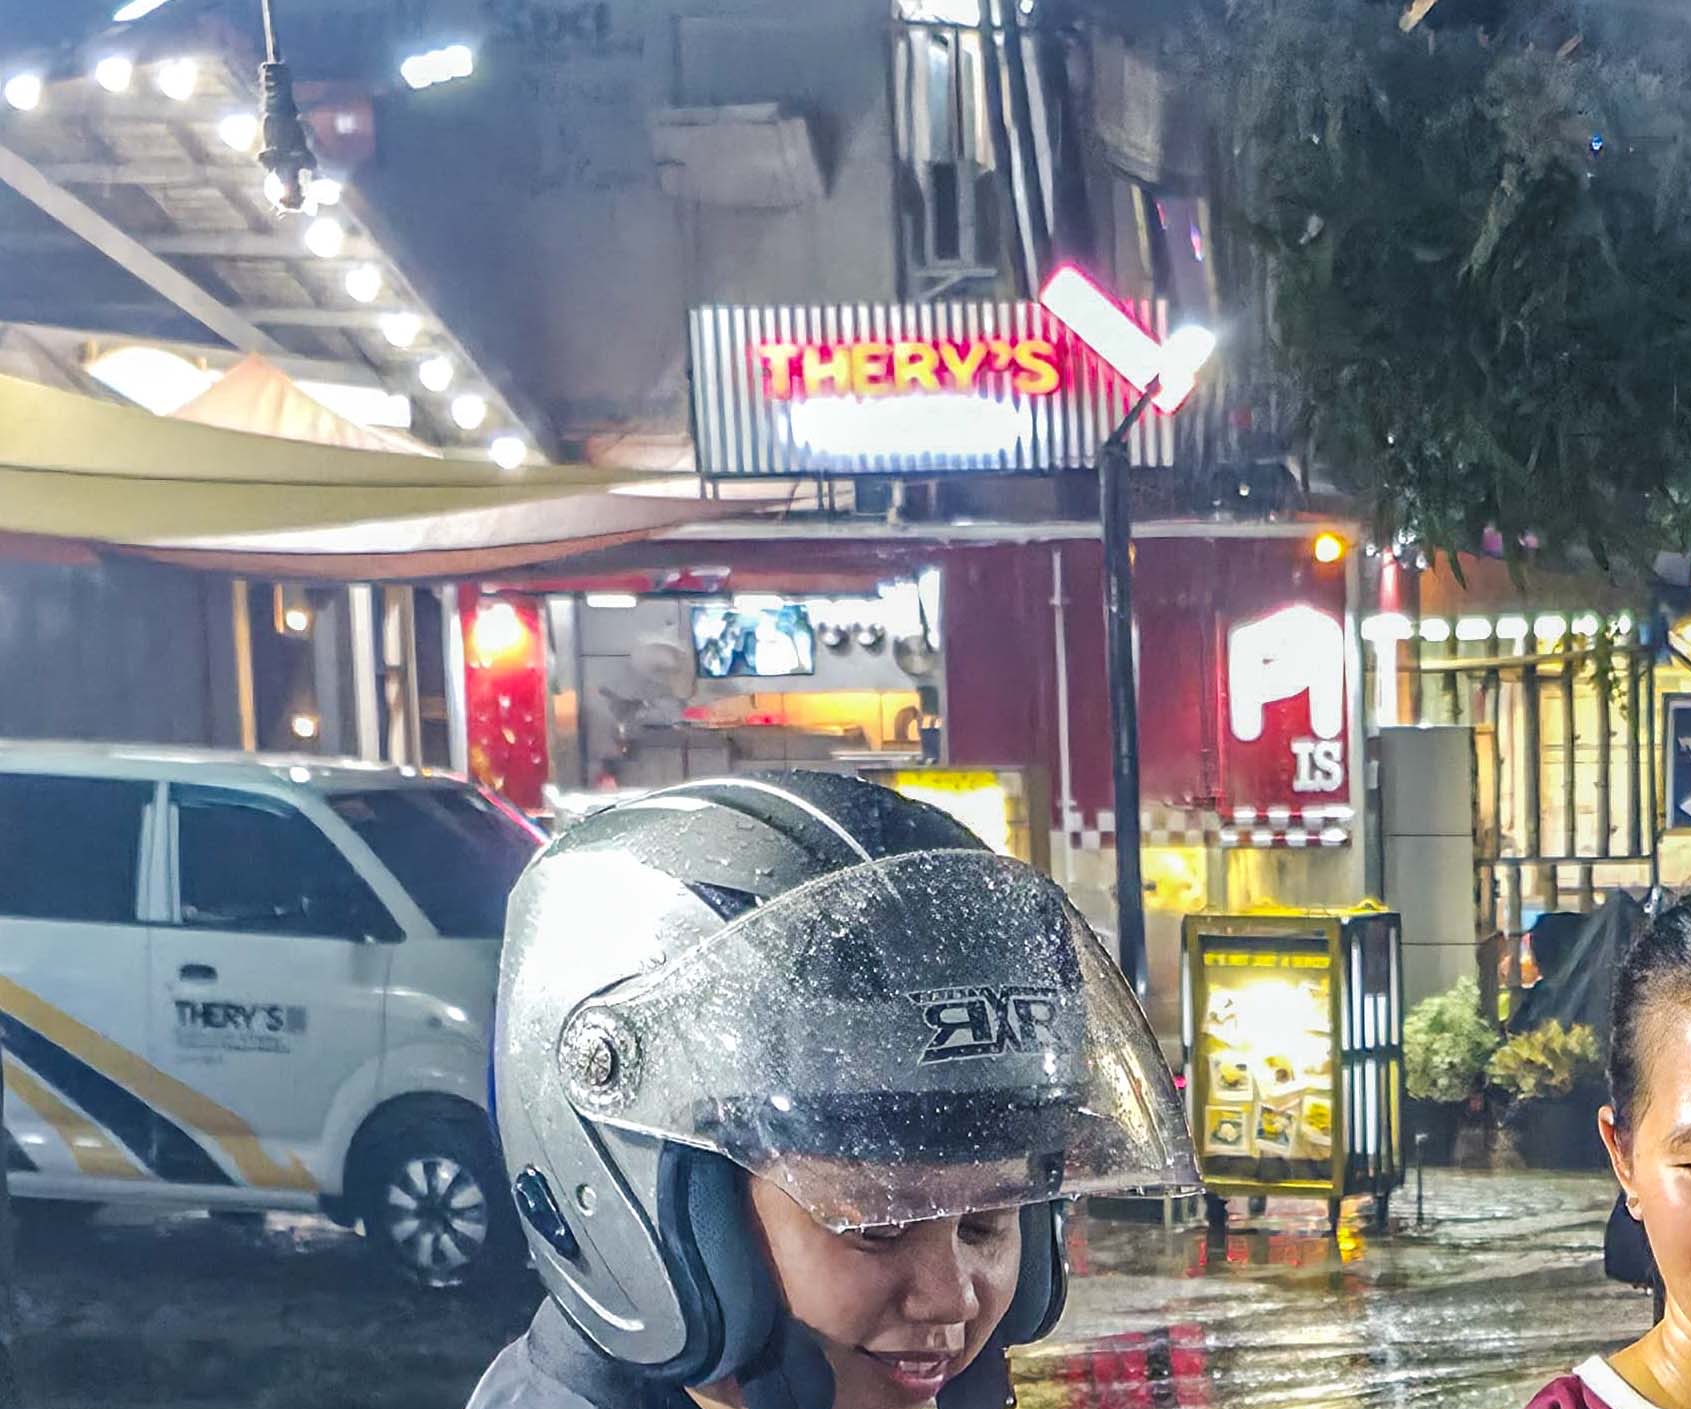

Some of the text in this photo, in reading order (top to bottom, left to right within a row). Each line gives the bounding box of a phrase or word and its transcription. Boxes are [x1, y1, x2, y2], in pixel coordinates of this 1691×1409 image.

[759, 339, 1061, 396] THERY'S
[1290, 740, 1344, 793] IS
[174, 1001, 285, 1032] THERY'S
